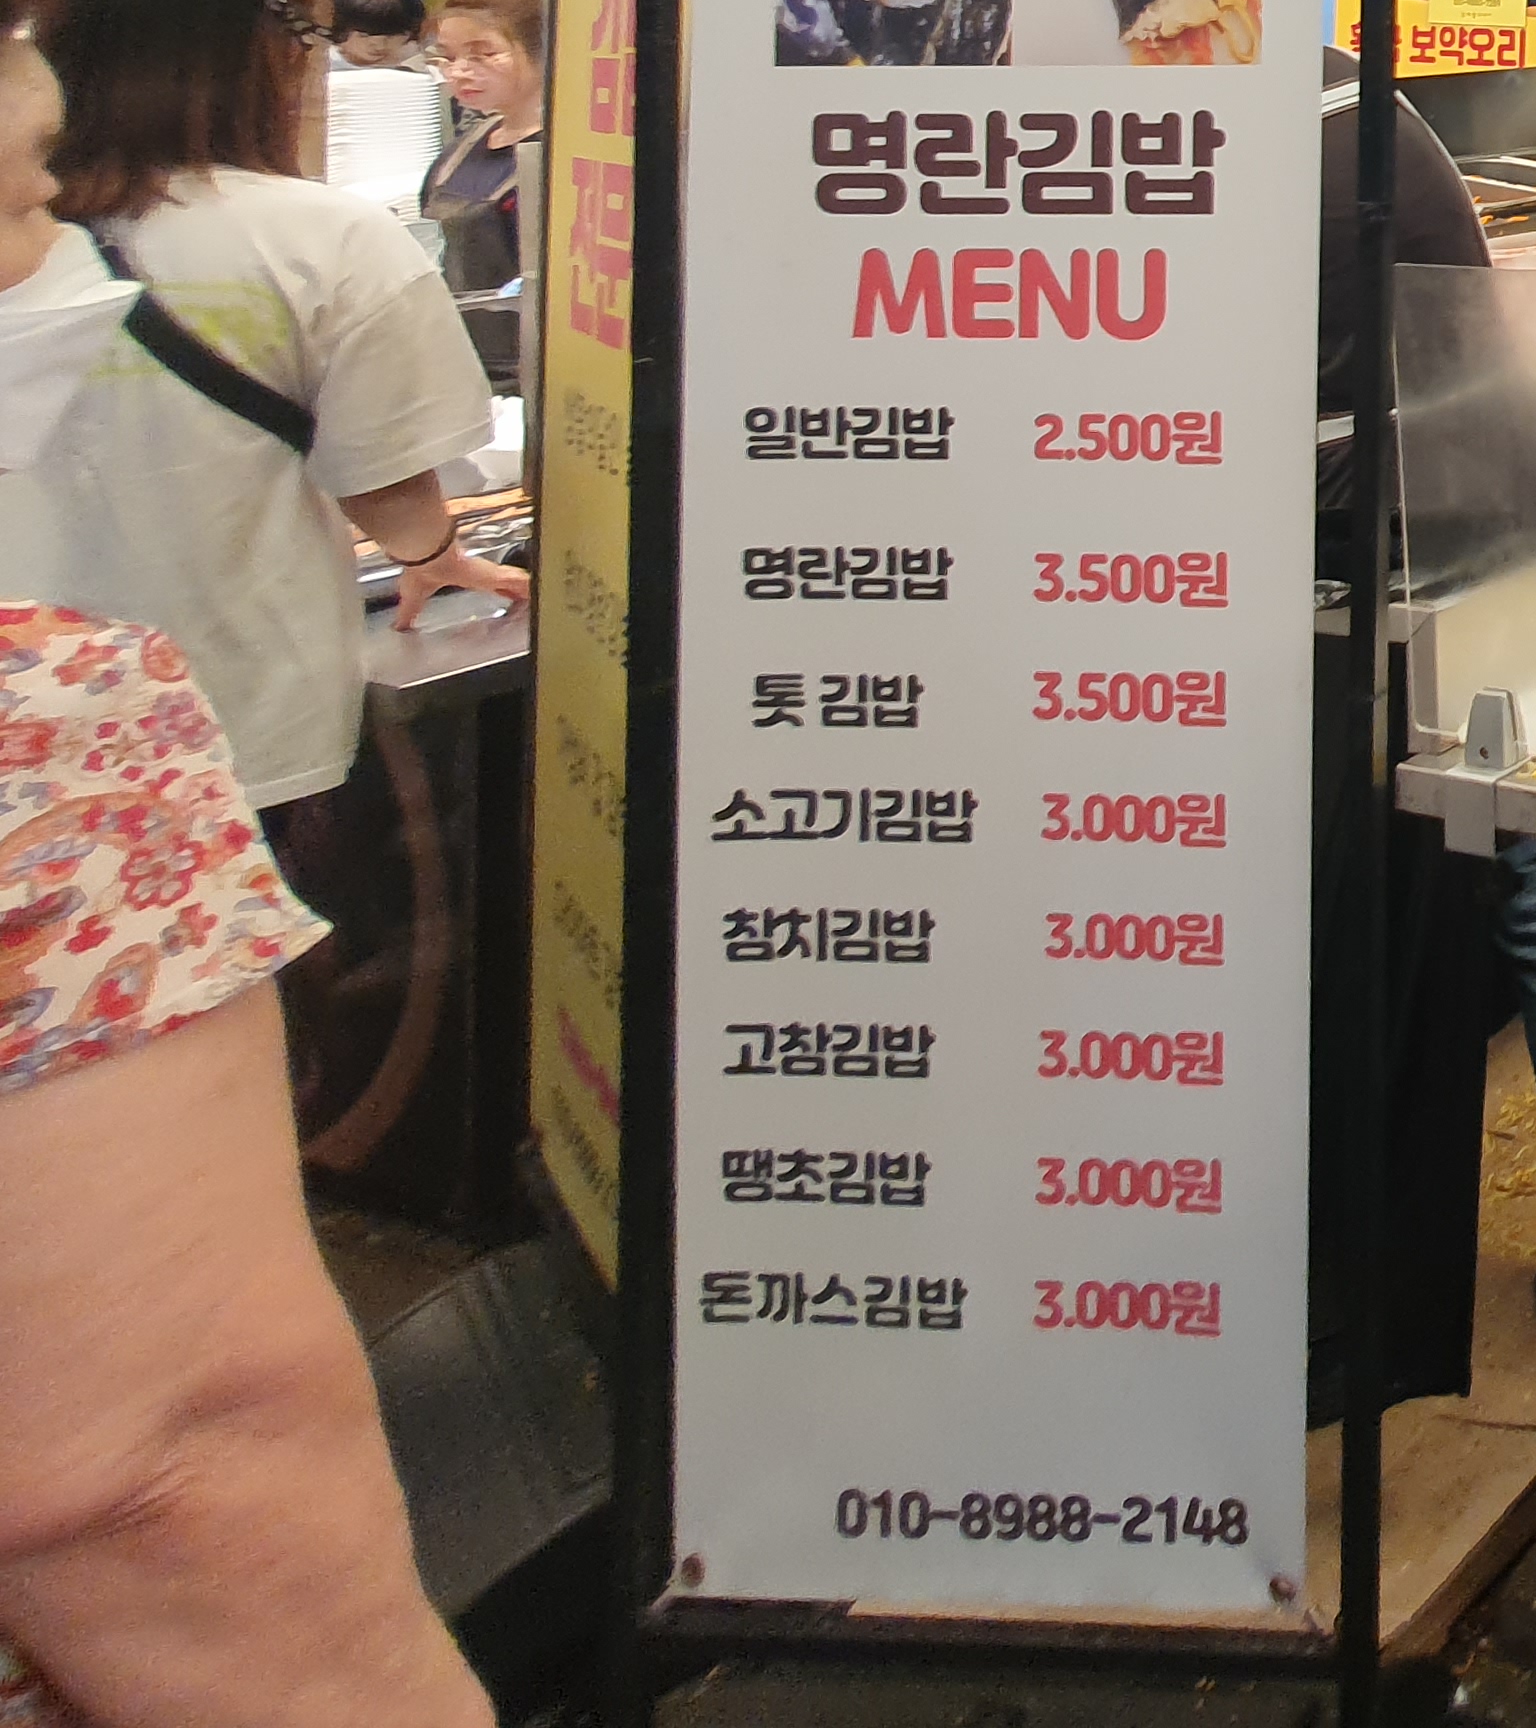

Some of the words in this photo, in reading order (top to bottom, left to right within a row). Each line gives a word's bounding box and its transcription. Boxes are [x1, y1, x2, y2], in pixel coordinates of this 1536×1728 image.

[812, 109, 1227, 215] 명란김밥
[851, 246, 1168, 341] MENU
[743, 404, 956, 462] 일반김밥
[1033, 409, 1224, 466] 2.500원
[741, 544, 955, 601] 명란김밥
[1032, 549, 1230, 609] 3.500원
[1032, 669, 1228, 728] 3.500원
[711, 788, 979, 844] 소고기김밥
[1040, 792, 1227, 849] 3.000원
[721, 907, 937, 964] 참치김밥
[1044, 911, 1226, 967] 3.000원
[721, 1022, 937, 1079] 고참김밥
[1036, 1029, 1225, 1087] 3.000원
[721, 1147, 932, 1208] 땡초김밥
[1034, 1156, 1223, 1215] 3.000원
[700, 1271, 968, 1330] 돈까스김밥
[1032, 1279, 1221, 1338] 3.000원
[835, 1487, 1249, 1546] 010-8988-2148
